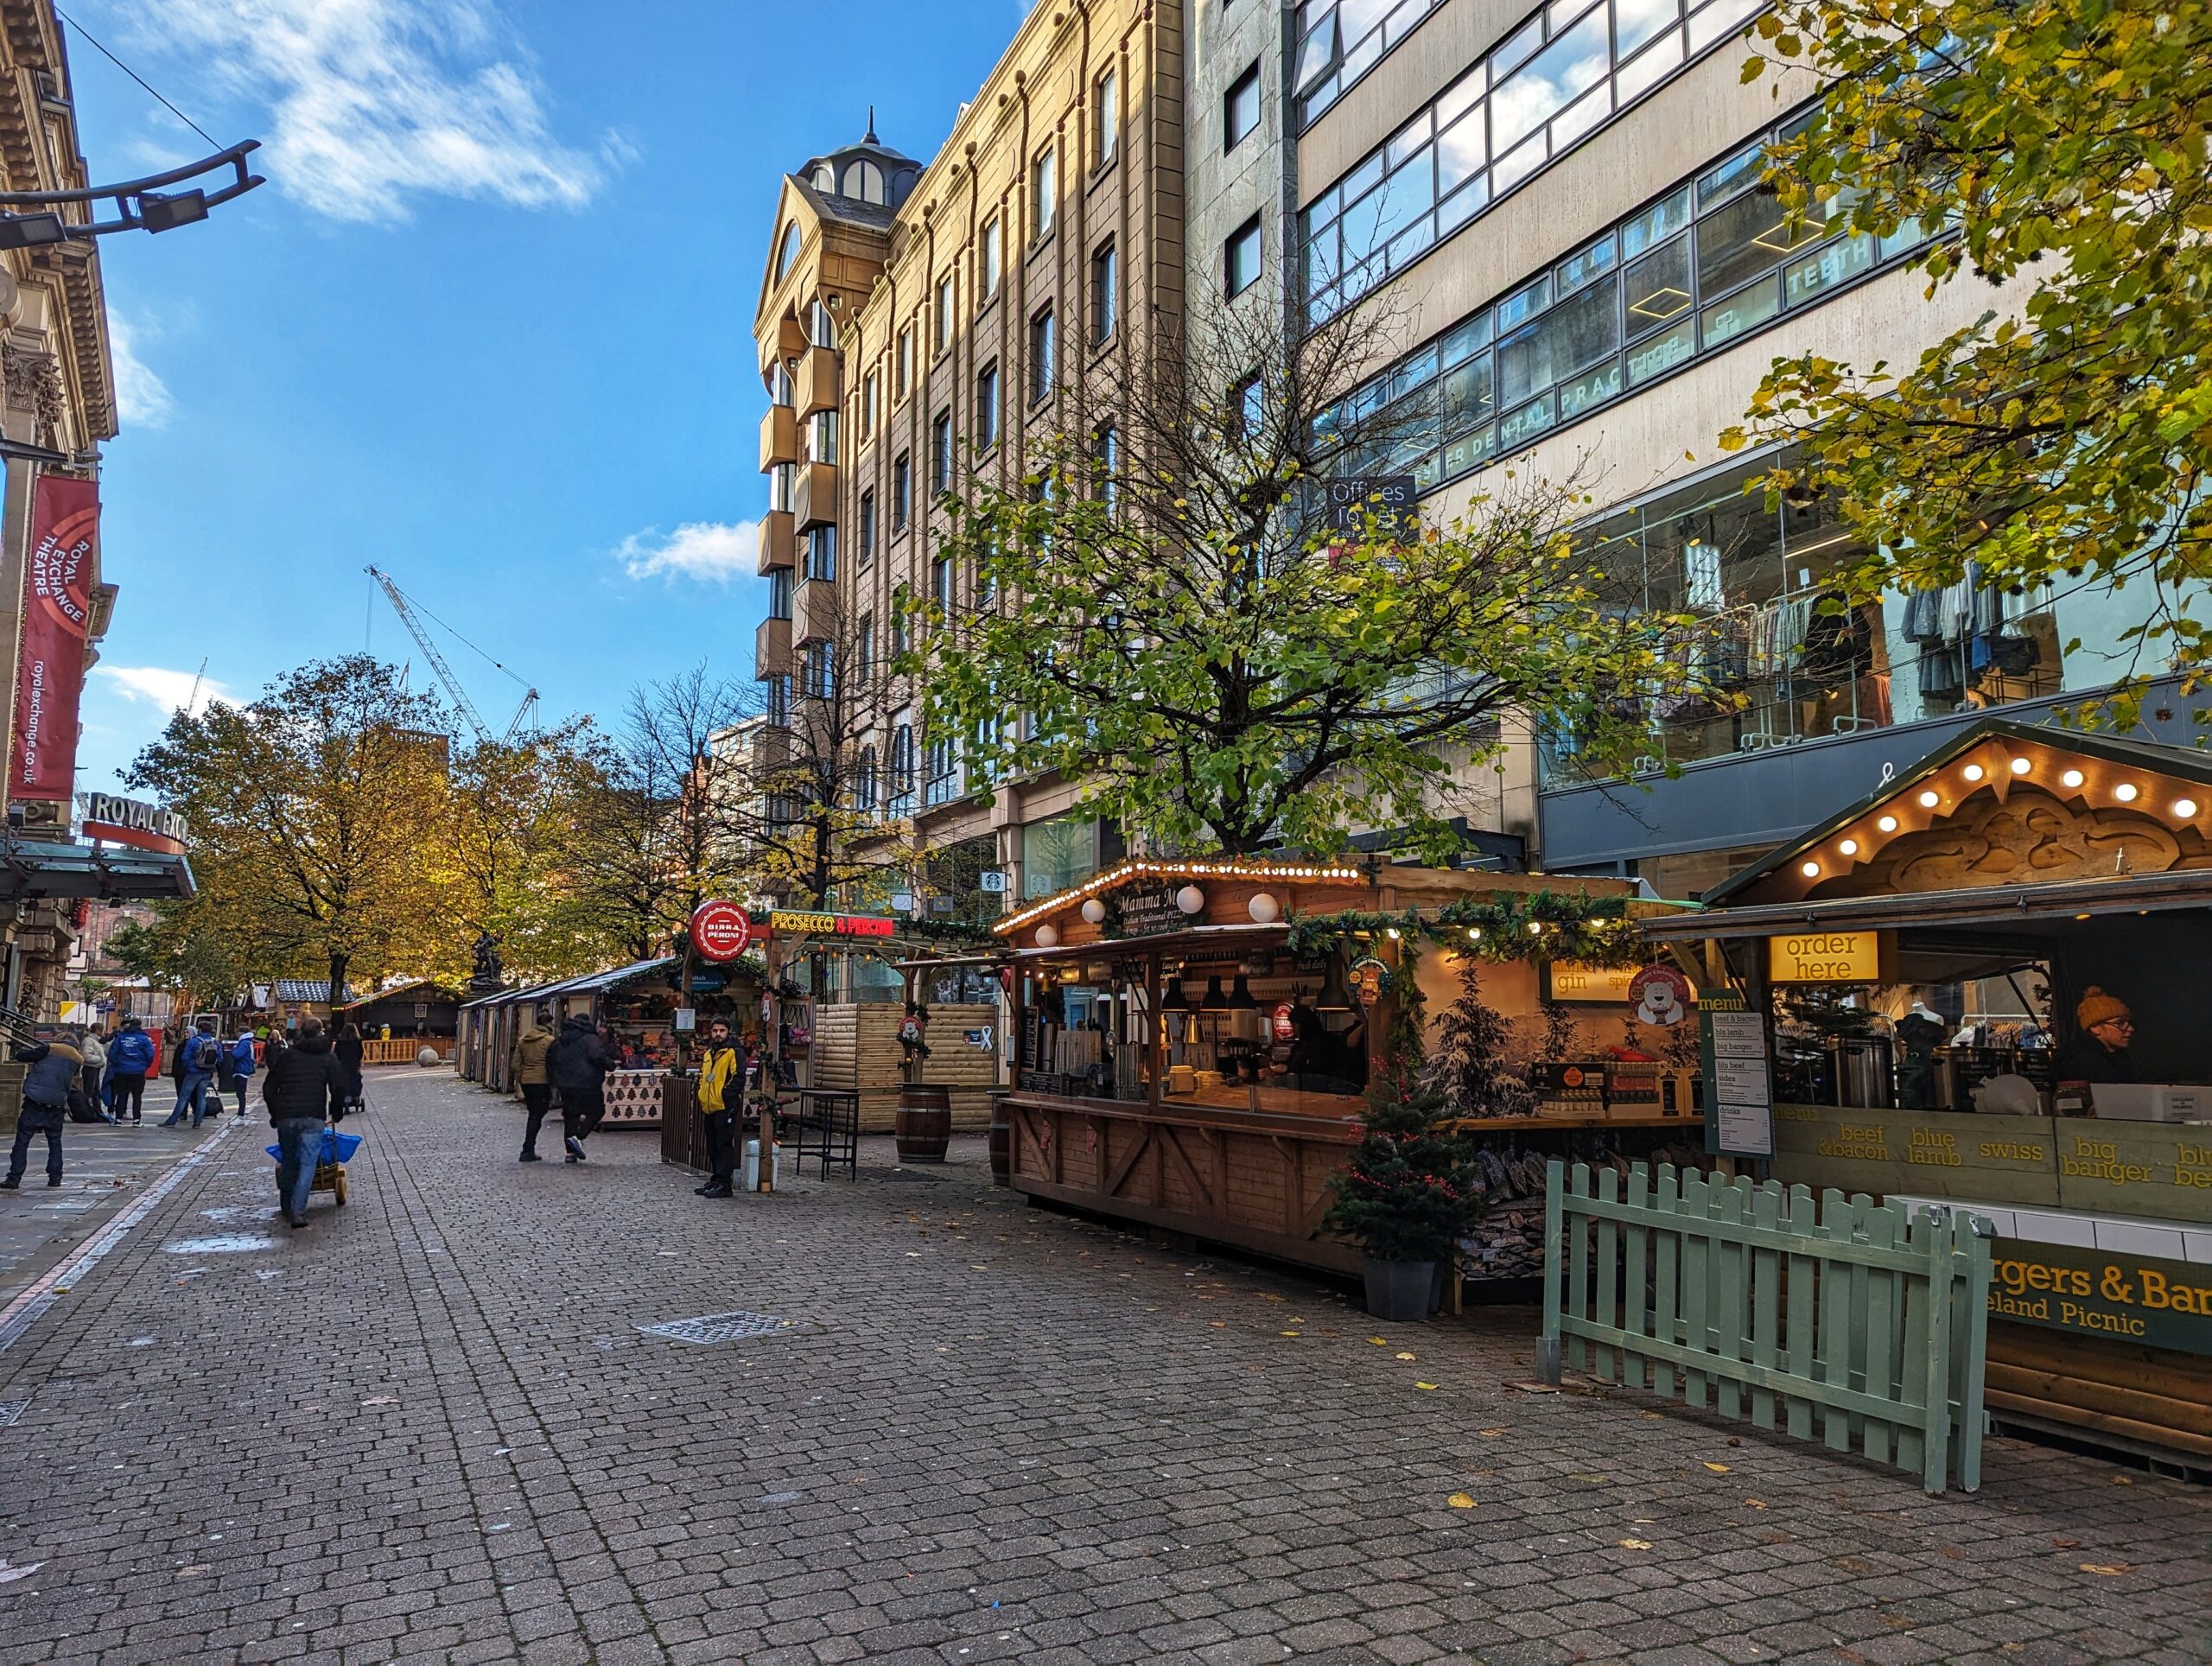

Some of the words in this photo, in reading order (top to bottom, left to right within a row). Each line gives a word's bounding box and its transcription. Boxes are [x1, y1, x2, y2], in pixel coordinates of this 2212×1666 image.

[1788, 238, 1870, 296] TEETH
[1472, 406, 1549, 456] DENTAL
[1366, 506, 1398, 525] et
[33, 535, 58, 596] THEATRE
[64, 540, 90, 584] ROYAL
[48, 549, 84, 621] EXCHANGE
[23, 660, 46, 784] royalexchange.co.uk
[94, 794, 156, 830] ROYAL
[1118, 893, 1160, 914] Mamma
[772, 912, 835, 933] PROSECCO
[836, 917, 847, 933] &
[848, 918, 894, 937] PERONI
[1123, 914, 1139, 925] Italian
[1140, 908, 1166, 923] Traditional
[1786, 933, 1858, 956] order
[1794, 957, 1852, 980] here
[1558, 973, 1587, 994] gin
[1608, 975, 1632, 990] spic
[1698, 998, 1745, 1011] menu
[1716, 1042, 1728, 1052] big
[1729, 1042, 1753, 1052] banger
[1839, 1122, 1885, 1142] beef
[1910, 1127, 1956, 1147] blue
[1908, 1144, 1962, 1167] lamb
[1979, 1141, 2044, 1160] swiss
[2075, 1135, 2117, 1164] big
[2061, 1154, 2152, 1186] banger
[2173, 1163, 2212, 1188] be
[2100, 1265, 2134, 1304] &
[1986, 1291, 2050, 1321] eland
[2060, 1301, 2145, 1337] Picnic
